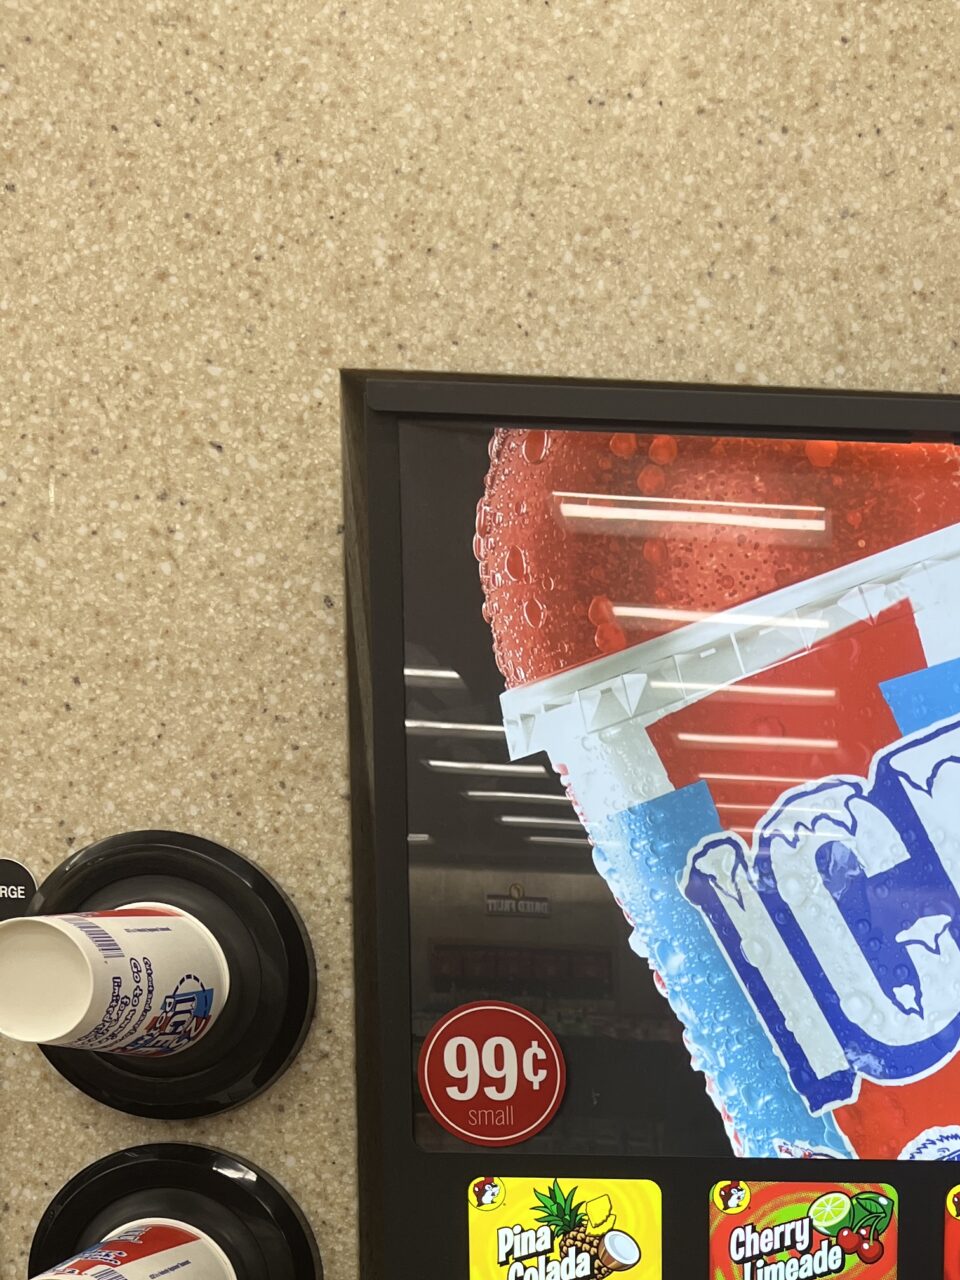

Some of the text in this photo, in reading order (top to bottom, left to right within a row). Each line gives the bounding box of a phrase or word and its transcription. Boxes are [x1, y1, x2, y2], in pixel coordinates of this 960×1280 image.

[0, 885, 26, 899] RGE
[443, 1036, 548, 1101] 99¢
[468, 1105, 514, 1126] small
[497, 1225, 553, 1265] Pina
[729, 1214, 815, 1263] Cherry
